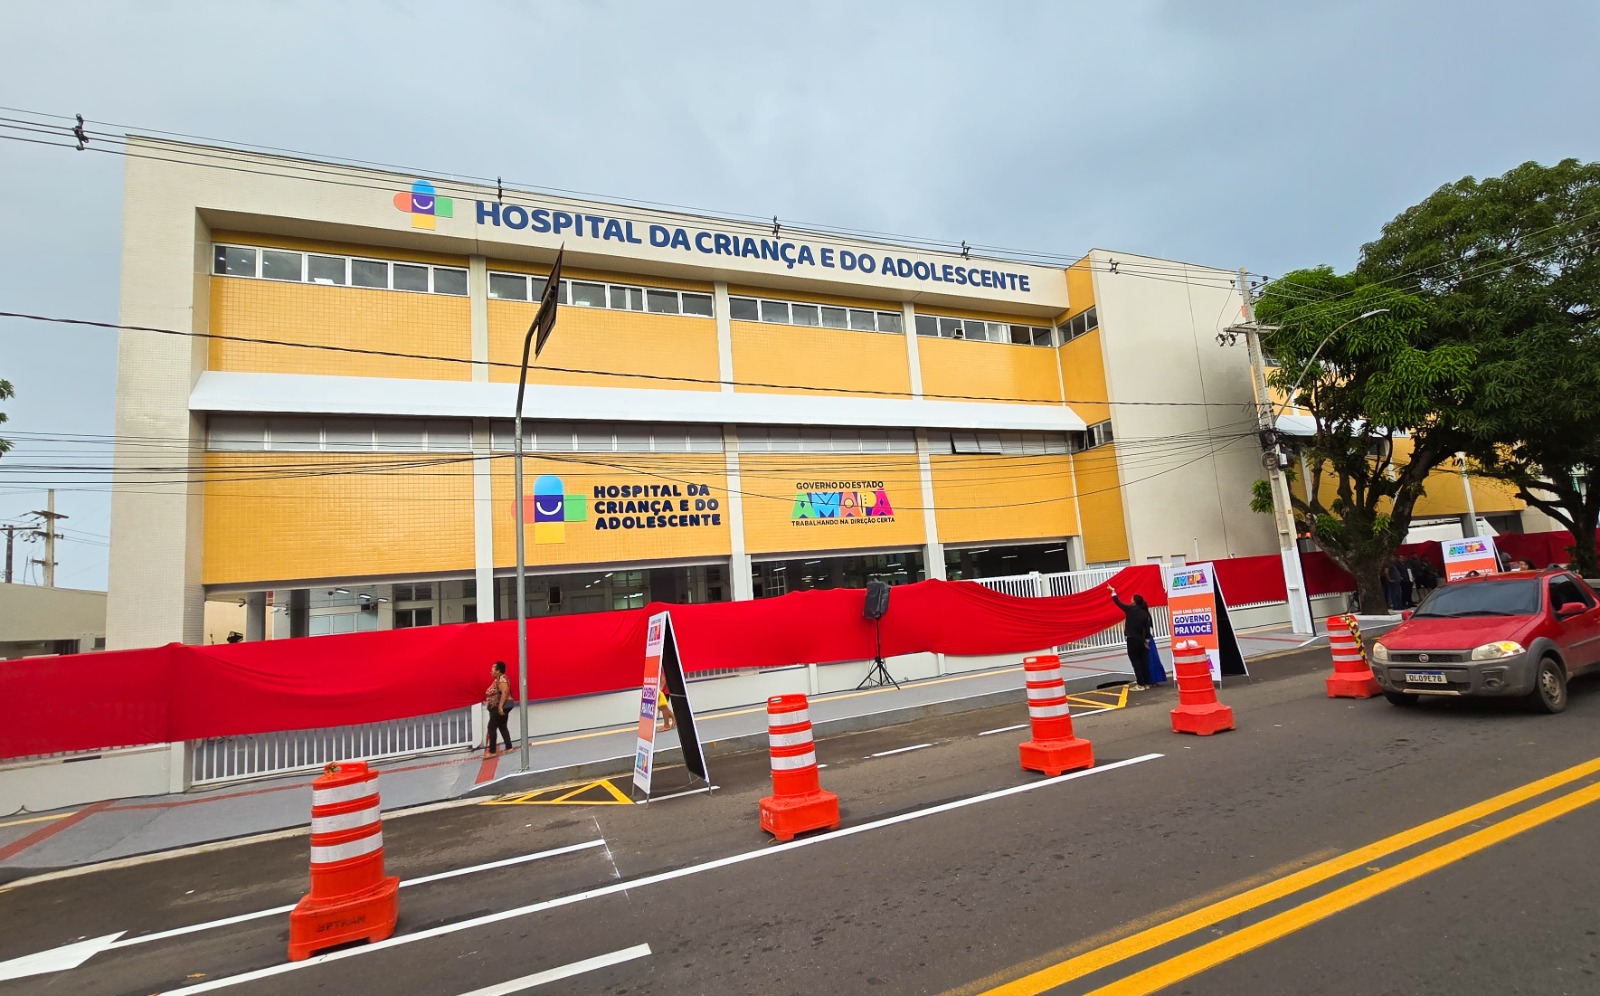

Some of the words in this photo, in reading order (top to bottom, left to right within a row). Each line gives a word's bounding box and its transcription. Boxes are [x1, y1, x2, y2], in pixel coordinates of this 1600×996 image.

[475, 199, 642, 245] HOSPITAL
[649, 224, 692, 252] DA
[694, 231, 816, 269] CRIANÇA
[820, 248, 835, 268] E
[839, 249, 876, 274] DO
[881, 257, 1031, 293] ADOLESCENTE
[593, 485, 682, 499] HOSPITAL
[687, 484, 710, 496] DA
[796, 481, 838, 490] GOVERNO
[838, 481, 852, 489] DO
[852, 480, 884, 489] ESTADO
[594, 500, 674, 516] CRIANÇA
[679, 499, 689, 511] E
[694, 498, 719, 511] DO
[595, 514, 721, 530] ADOLESCENTE
[791, 519, 839, 527] TRABALHANDO
[850, 516, 876, 525] DIREÇÃO
[1175, 614, 1210, 623] GOVERNO
[1174, 626, 1190, 635] PRA
[1189, 622, 1212, 634] VOCÊ
